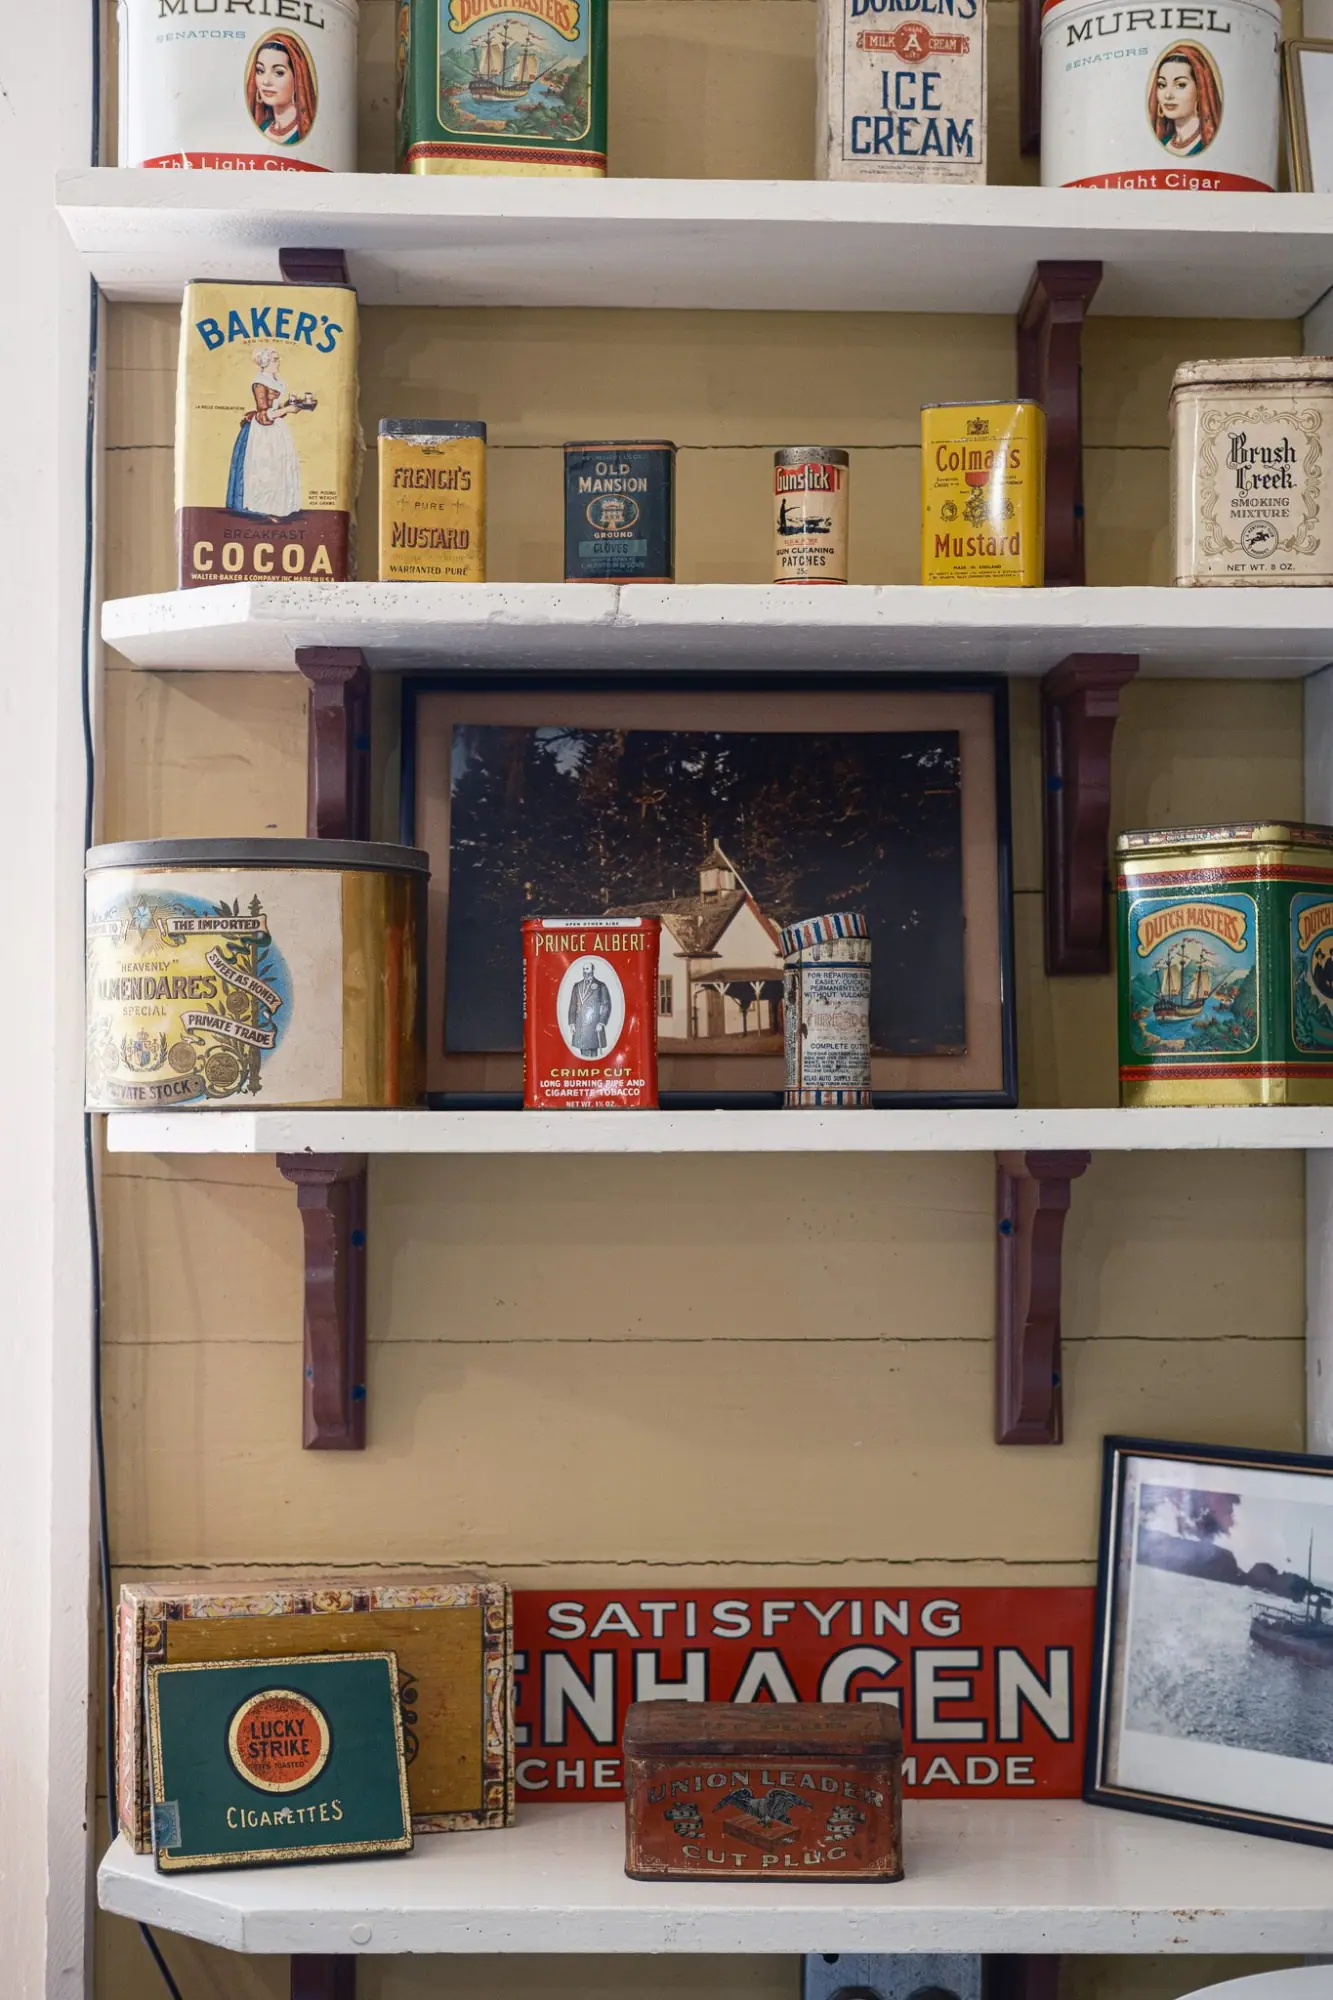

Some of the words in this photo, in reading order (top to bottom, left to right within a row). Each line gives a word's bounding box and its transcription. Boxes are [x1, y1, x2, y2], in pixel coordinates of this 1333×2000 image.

[158, 0, 324, 29] MURIEL
[156, 31, 246, 43] SENATORS
[1066, 9, 1231, 47] MURIEL
[869, 36, 895, 47] MILK
[904, 33, 922, 51] A
[929, 38, 956, 50] CREAM
[1065, 47, 1148, 72] SENATORS
[881, 71, 943, 110] ICE
[851, 116, 974, 157] CREAM
[1165, 173, 1220, 191] Cigar
[196, 307, 343, 353] BAKER'S
[936, 444, 1020, 472] Colma's
[1226, 432, 1298, 469] Brush
[393, 466, 471, 491] FRENCH'S
[595, 462, 630, 476] OLD
[578, 476, 647, 493] MANSION
[415, 502, 445, 511] PURE
[1230, 509, 1290, 518] MIXTURE
[1231, 498, 1290, 508] SMOKING
[223, 528, 307, 540] BREAKFAST
[391, 521, 470, 550] MUSTARD
[593, 531, 633, 539] GROUND
[934, 532, 1020, 558] Mustard
[193, 541, 333, 574] COCOA
[782, 556, 826, 567] PATCHES
[1227, 564, 1246, 572] NET
[390, 565, 441, 576] WARRANTED
[445, 566, 468, 576] PURE
[173, 920, 195, 930] THE
[198, 919, 260, 930] IMPORTED
[1145, 910, 1184, 948] DUTCH
[1187, 908, 1239, 944] MASTERS
[1304, 907, 1330, 943] DUTCH
[535, 932, 587, 956] PRINCE
[593, 933, 645, 952] ALBERT
[99, 975, 217, 1000] LMENDARES
[209, 953, 235, 980] SWEET
[235, 974, 249, 989] AS
[248, 979, 280, 1008] HONEY
[123, 1004, 167, 1016] SPECIAL
[188, 1014, 231, 1032] PRIVATE
[235, 1026, 270, 1045] TRADE
[540, 1080, 560, 1088] LONG
[563, 1080, 602, 1088] BURNING
[626, 1079, 645, 1087] AND
[551, 1068, 600, 1077] CRIMP
[604, 1067, 632, 1077] CUT
[150, 1079, 190, 1099] STOCK
[545, 1088, 595, 1097] CIGARETTE
[599, 1088, 640, 1096] TOBACCO
[548, 1600, 962, 1638] SATISFYING
[514, 1646, 1070, 1743] NHAGEN
[251, 1719, 305, 1740] LUCKY
[248, 1738, 310, 1759] STRIKE
[646, 1771, 749, 1803] UNION
[760, 1769, 884, 1809] LEADER
[226, 1799, 343, 1829] CIGARETTES
[682, 1845, 747, 1867] CUT
[762, 1846, 846, 1868] PLUG
